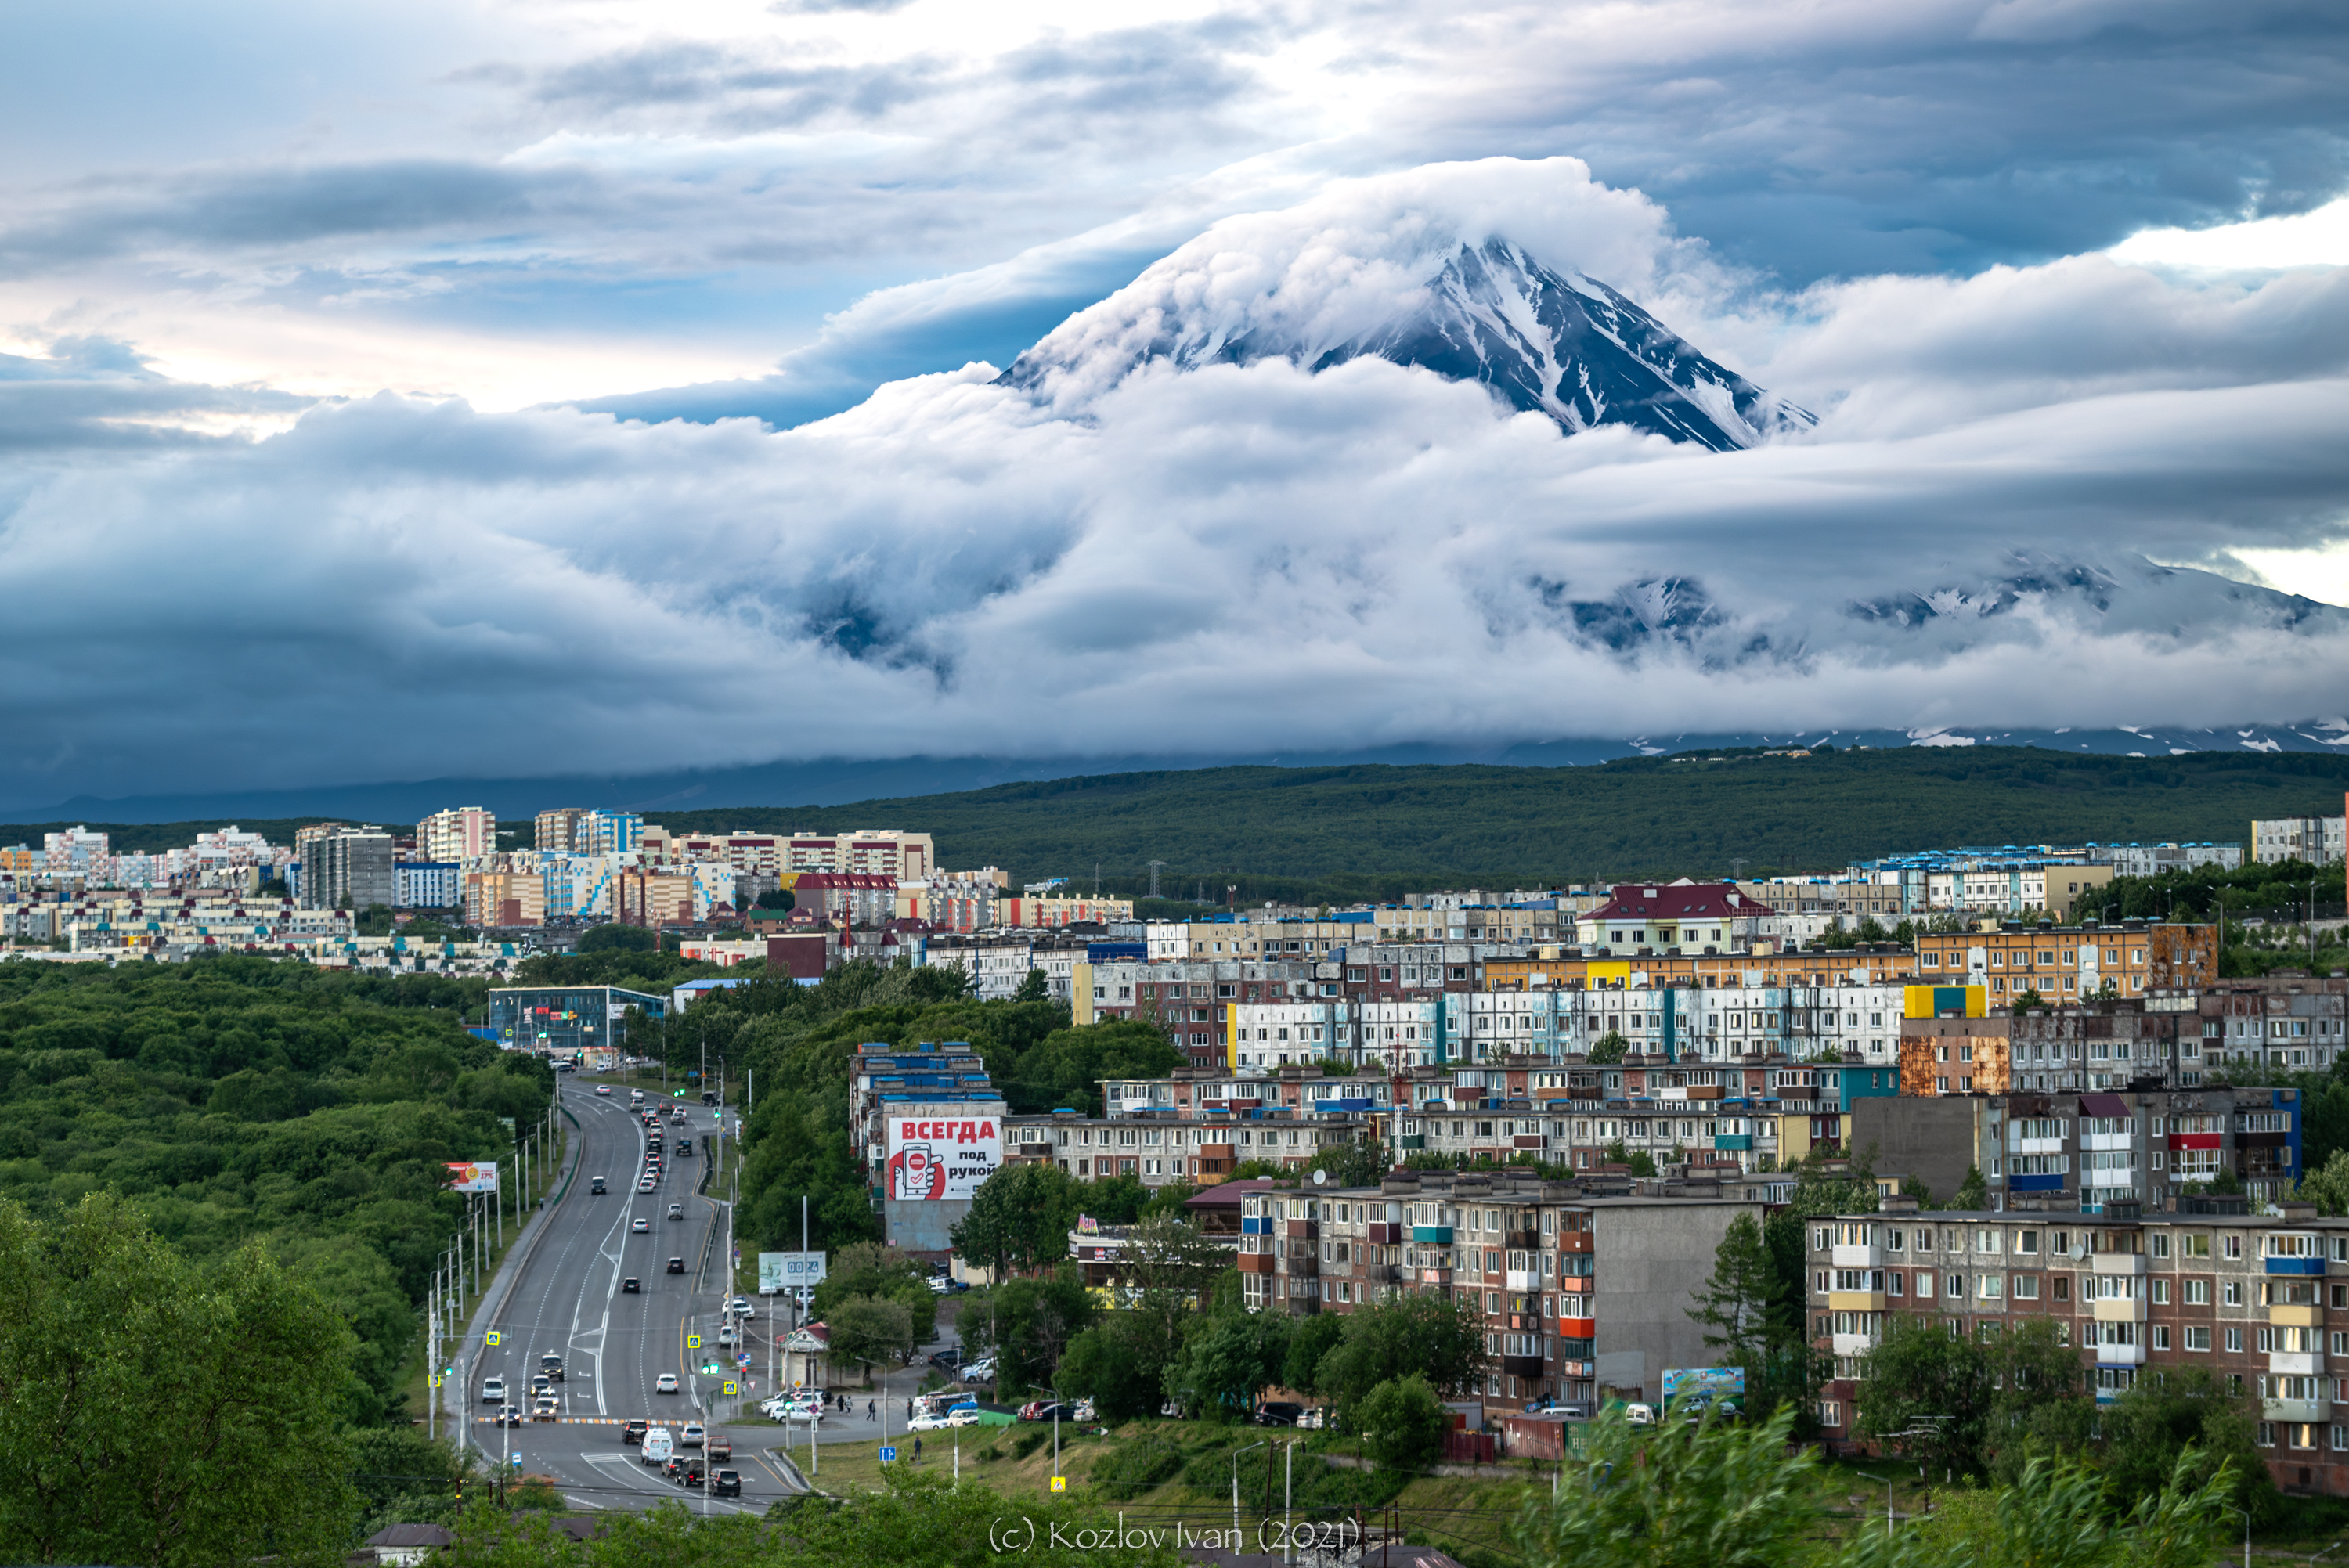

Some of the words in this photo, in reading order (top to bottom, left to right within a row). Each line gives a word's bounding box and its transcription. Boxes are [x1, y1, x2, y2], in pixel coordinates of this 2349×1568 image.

[902, 1121, 995, 1144] ВСЕГДА
[959, 1152, 987, 1162] под
[949, 1163, 996, 1179] рукой
